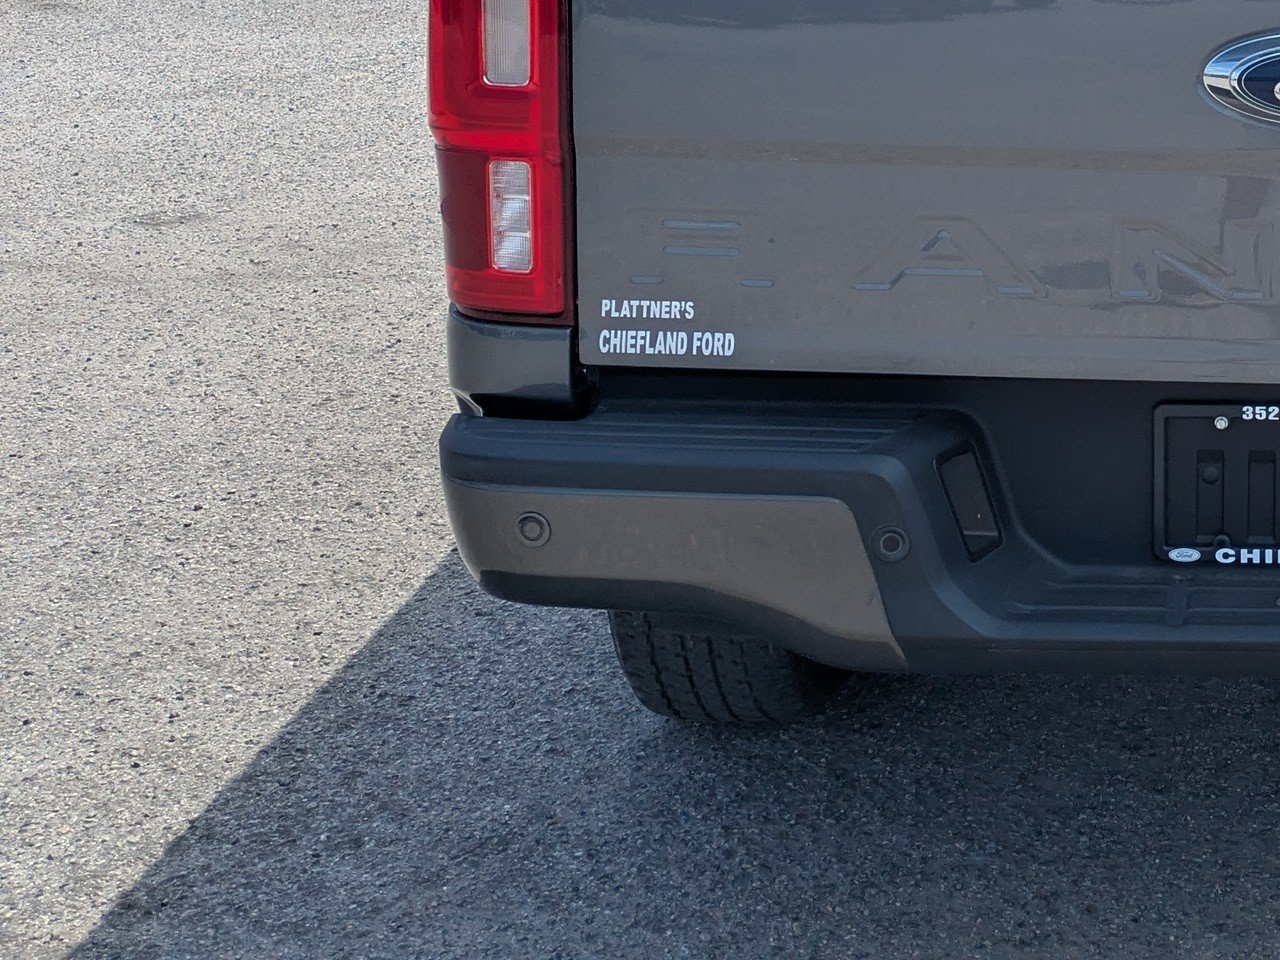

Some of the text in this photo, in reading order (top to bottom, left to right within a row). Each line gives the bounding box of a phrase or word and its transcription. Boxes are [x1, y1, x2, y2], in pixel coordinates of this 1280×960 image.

[601, 299, 695, 320] PLATTNER'S
[599, 329, 735, 356] CHIEFLAND FORD
